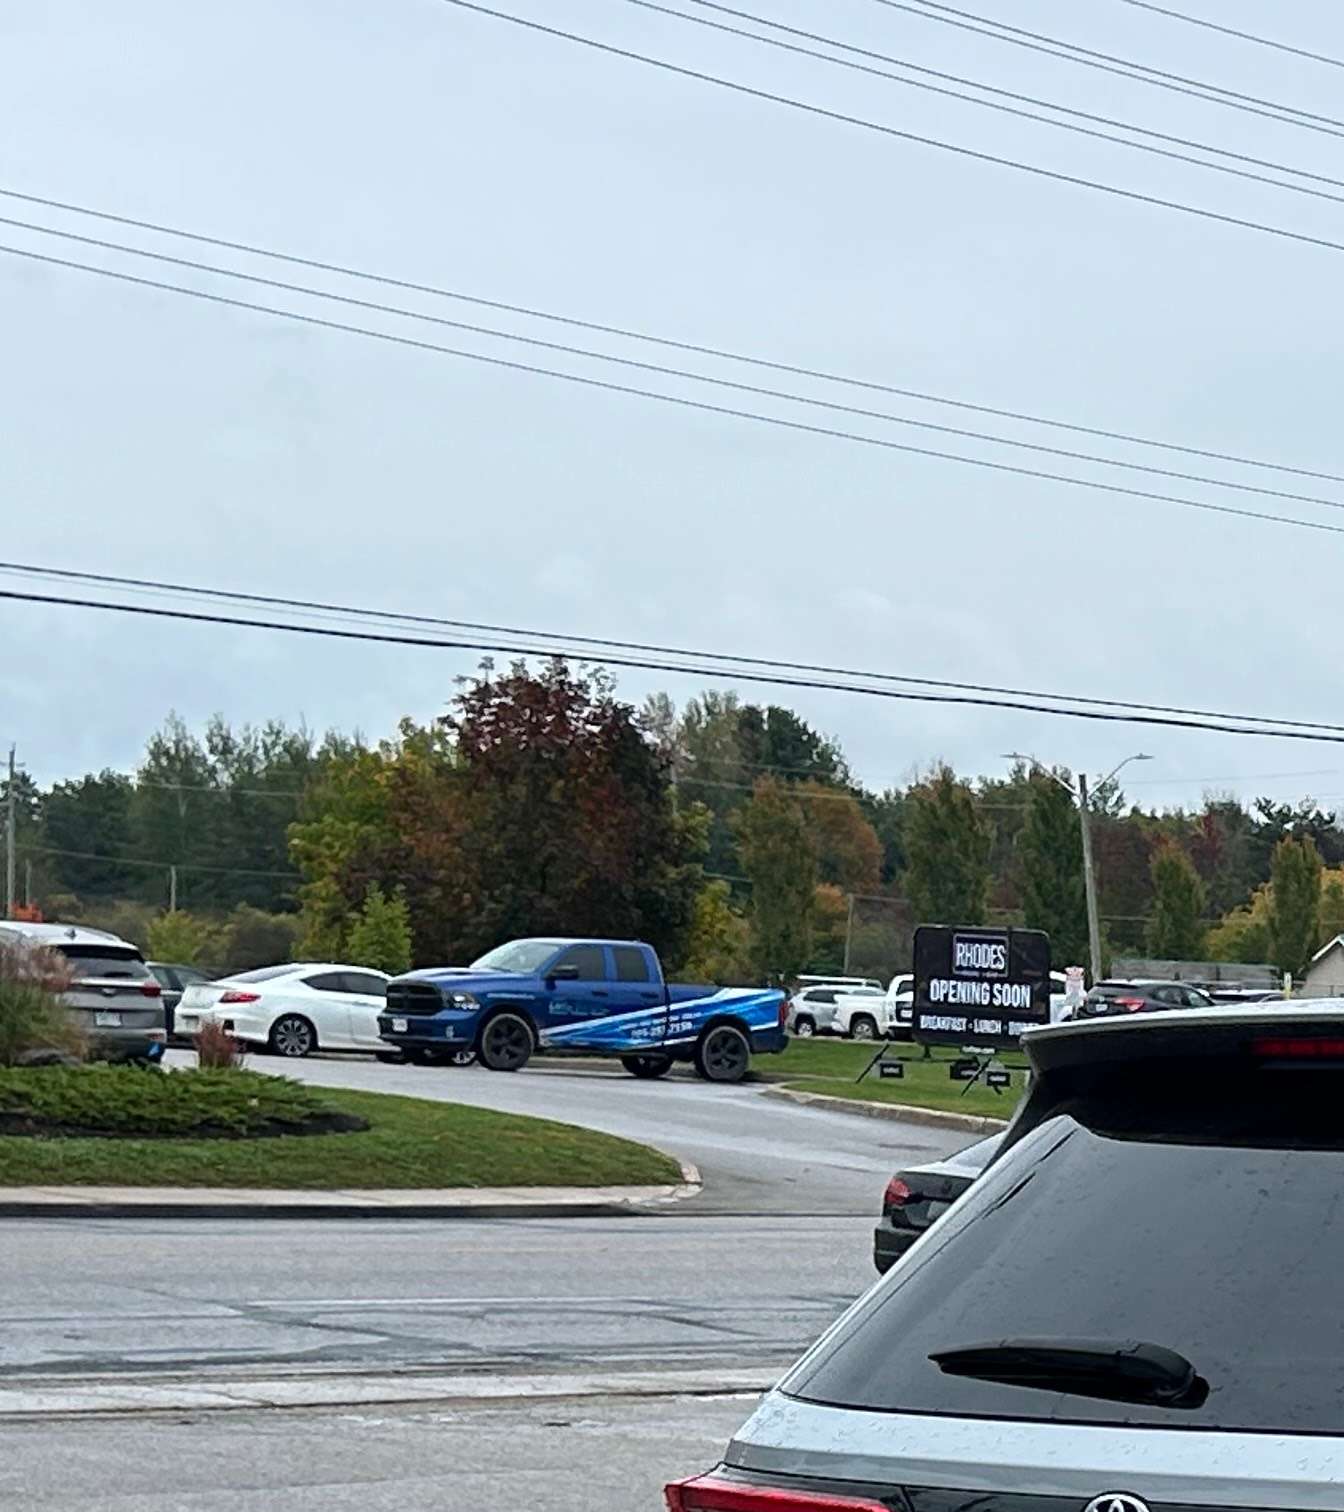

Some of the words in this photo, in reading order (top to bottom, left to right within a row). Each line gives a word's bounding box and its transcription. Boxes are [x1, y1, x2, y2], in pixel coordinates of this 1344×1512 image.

[956, 942, 1005, 970] RHODES
[930, 978, 991, 1006] OPENING
[992, 983, 1031, 1008] SOON
